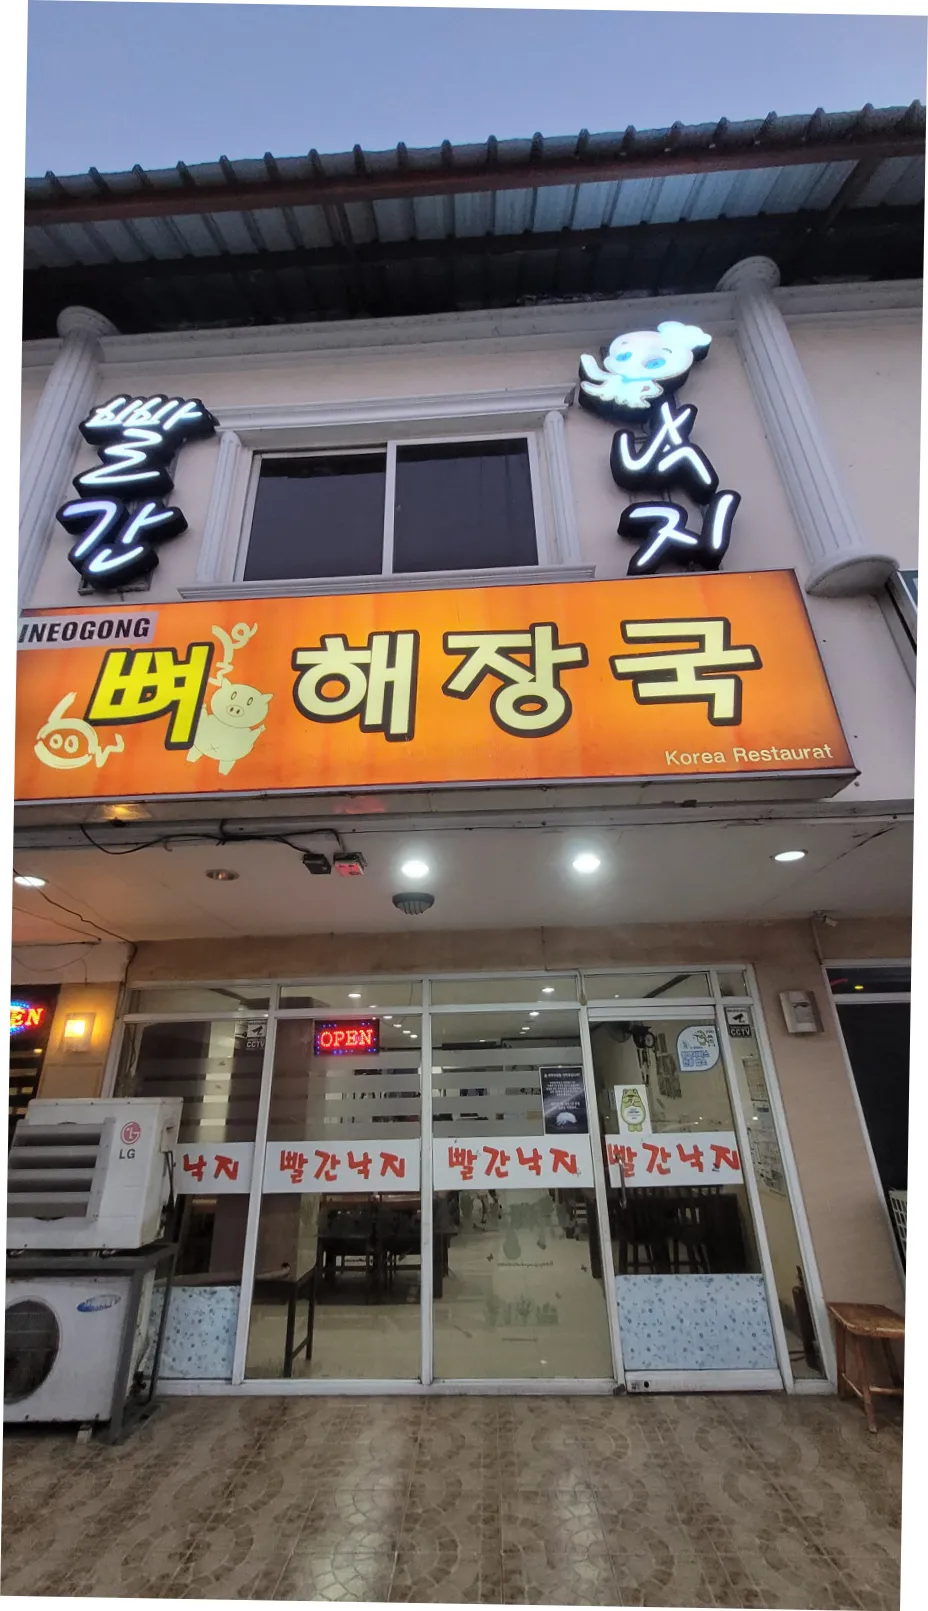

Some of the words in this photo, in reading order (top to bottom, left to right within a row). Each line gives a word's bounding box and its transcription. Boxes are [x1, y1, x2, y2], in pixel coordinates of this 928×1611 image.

[665, 750, 726, 766] Korea
[732, 744, 834, 763] Restaurat
[320, 1029, 373, 1047] OPEN
[730, 1028, 750, 1036] CCTV
[246, 1040, 265, 1048] CCTV
[119, 1148, 136, 1159] LG
[448, 1146, 578, 1180] 빨간낙지
[183, 1153, 239, 1182] 낙지
[280, 1150, 405, 1184] 빨간낙지
